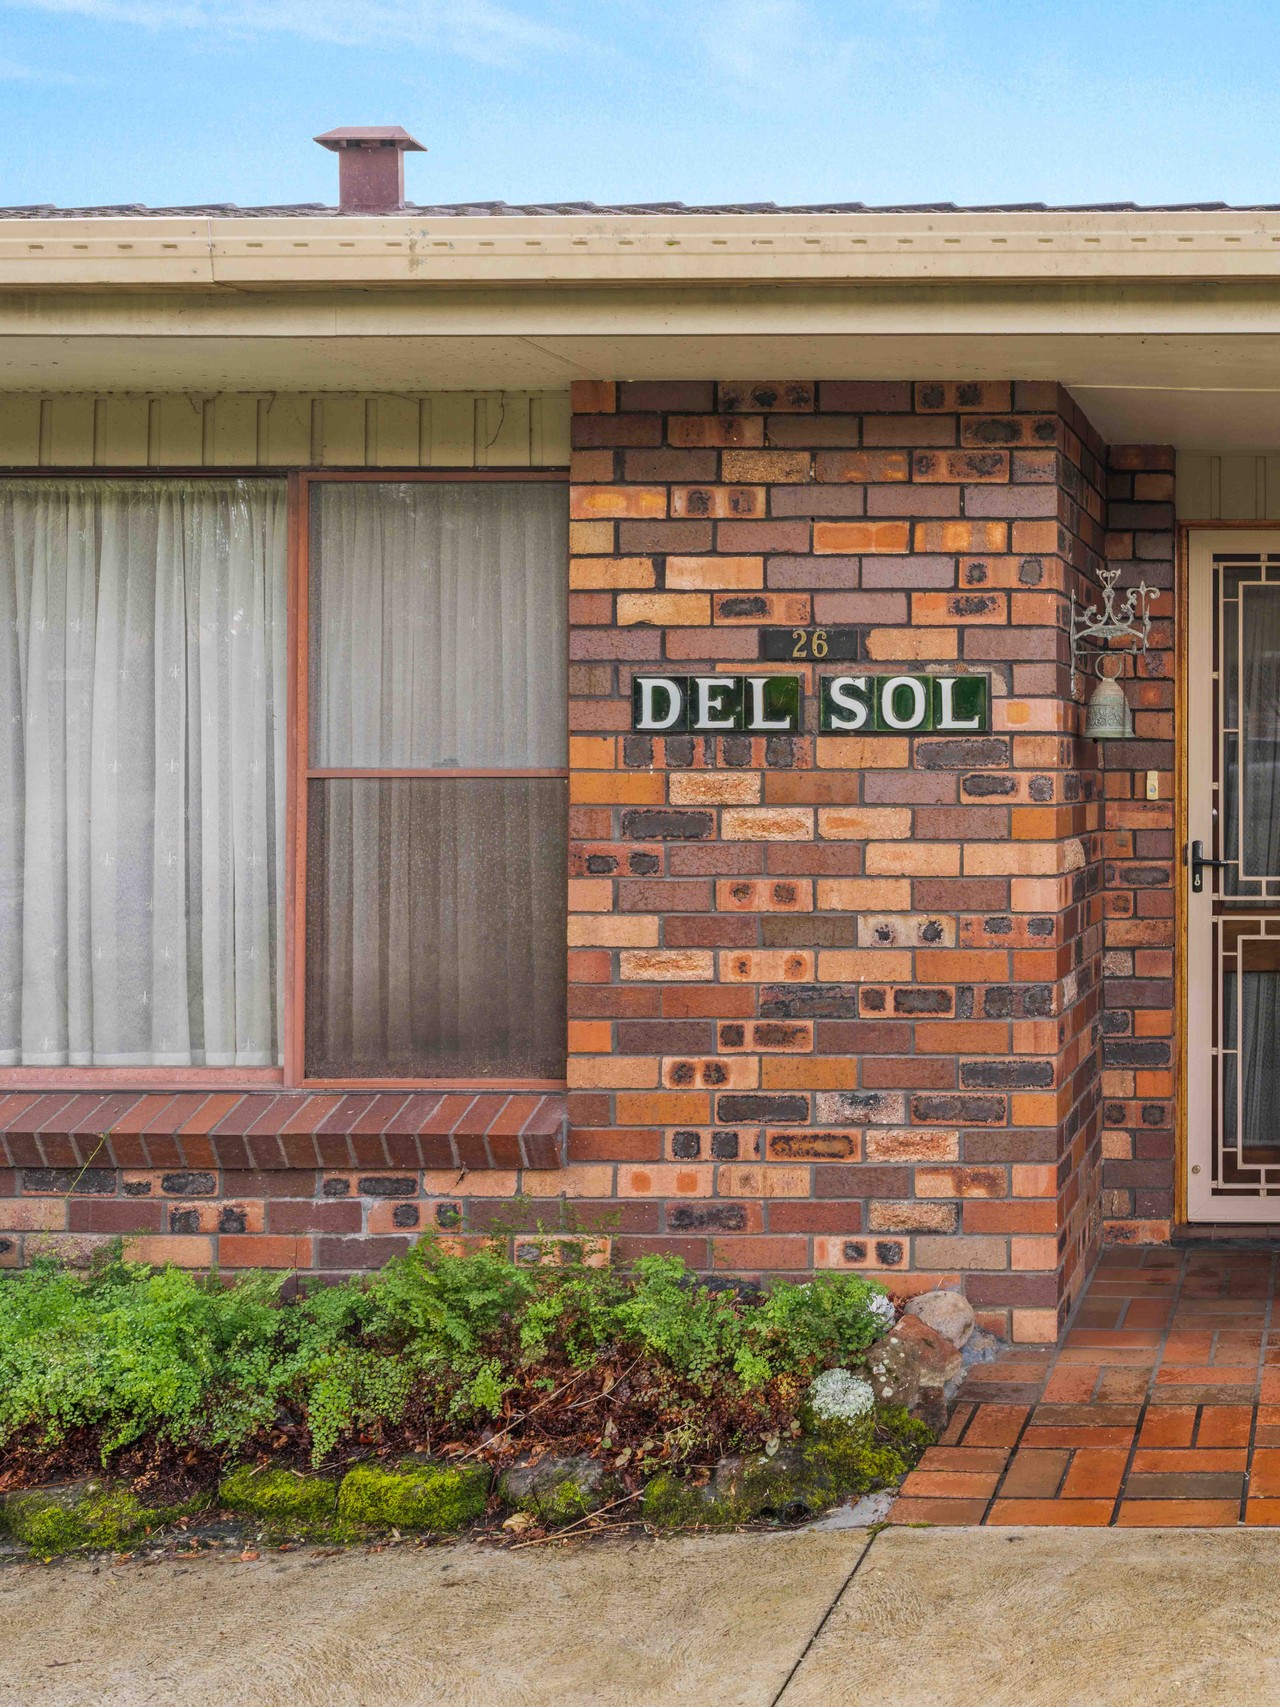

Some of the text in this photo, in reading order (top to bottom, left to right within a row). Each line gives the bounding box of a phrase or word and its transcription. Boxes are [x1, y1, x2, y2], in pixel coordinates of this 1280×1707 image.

[792, 630, 828, 658] 26
[636, 677, 979, 730] DEL SOL
